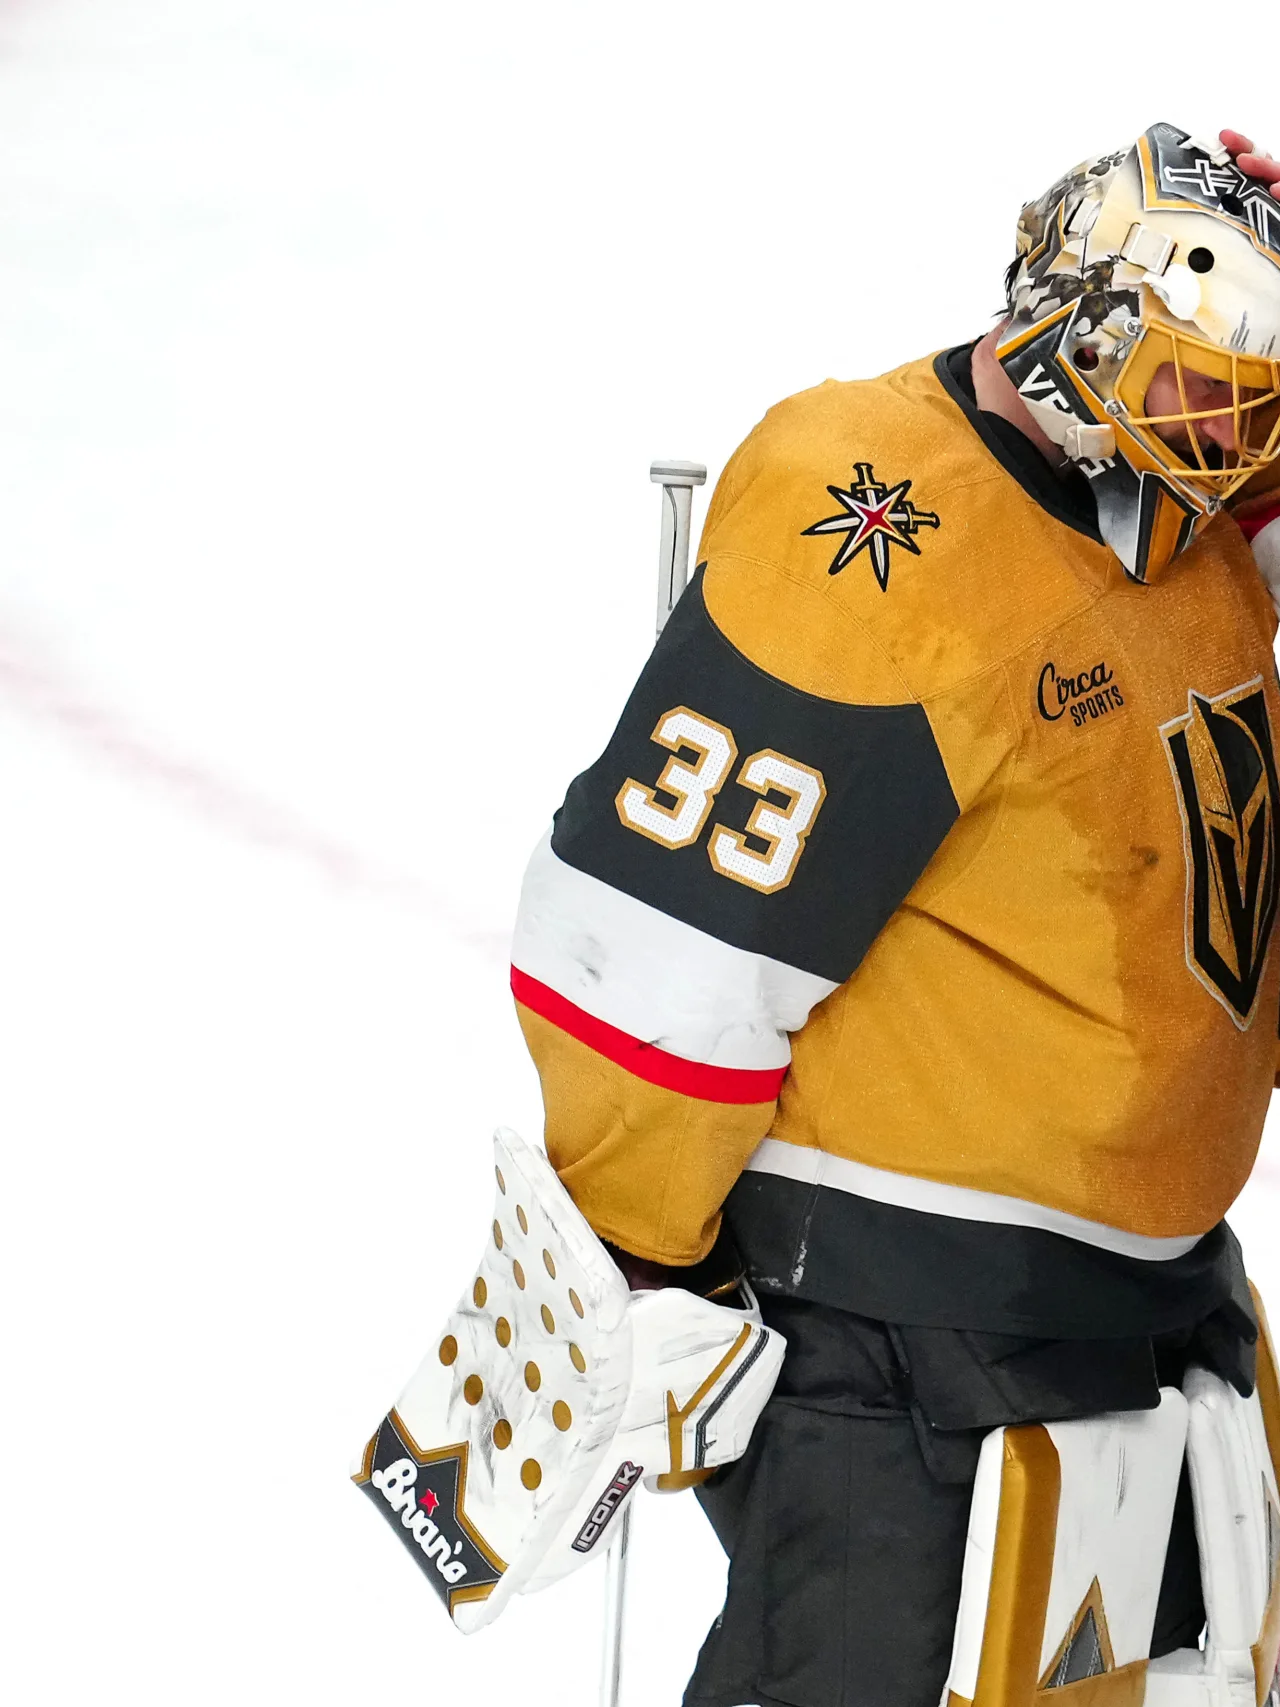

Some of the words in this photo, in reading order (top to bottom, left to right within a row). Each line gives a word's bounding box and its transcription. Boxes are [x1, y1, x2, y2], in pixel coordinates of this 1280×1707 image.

[1037, 662, 1113, 721] Circa
[1070, 685, 1124, 727] SPORTS
[614, 705, 828, 895] 33
